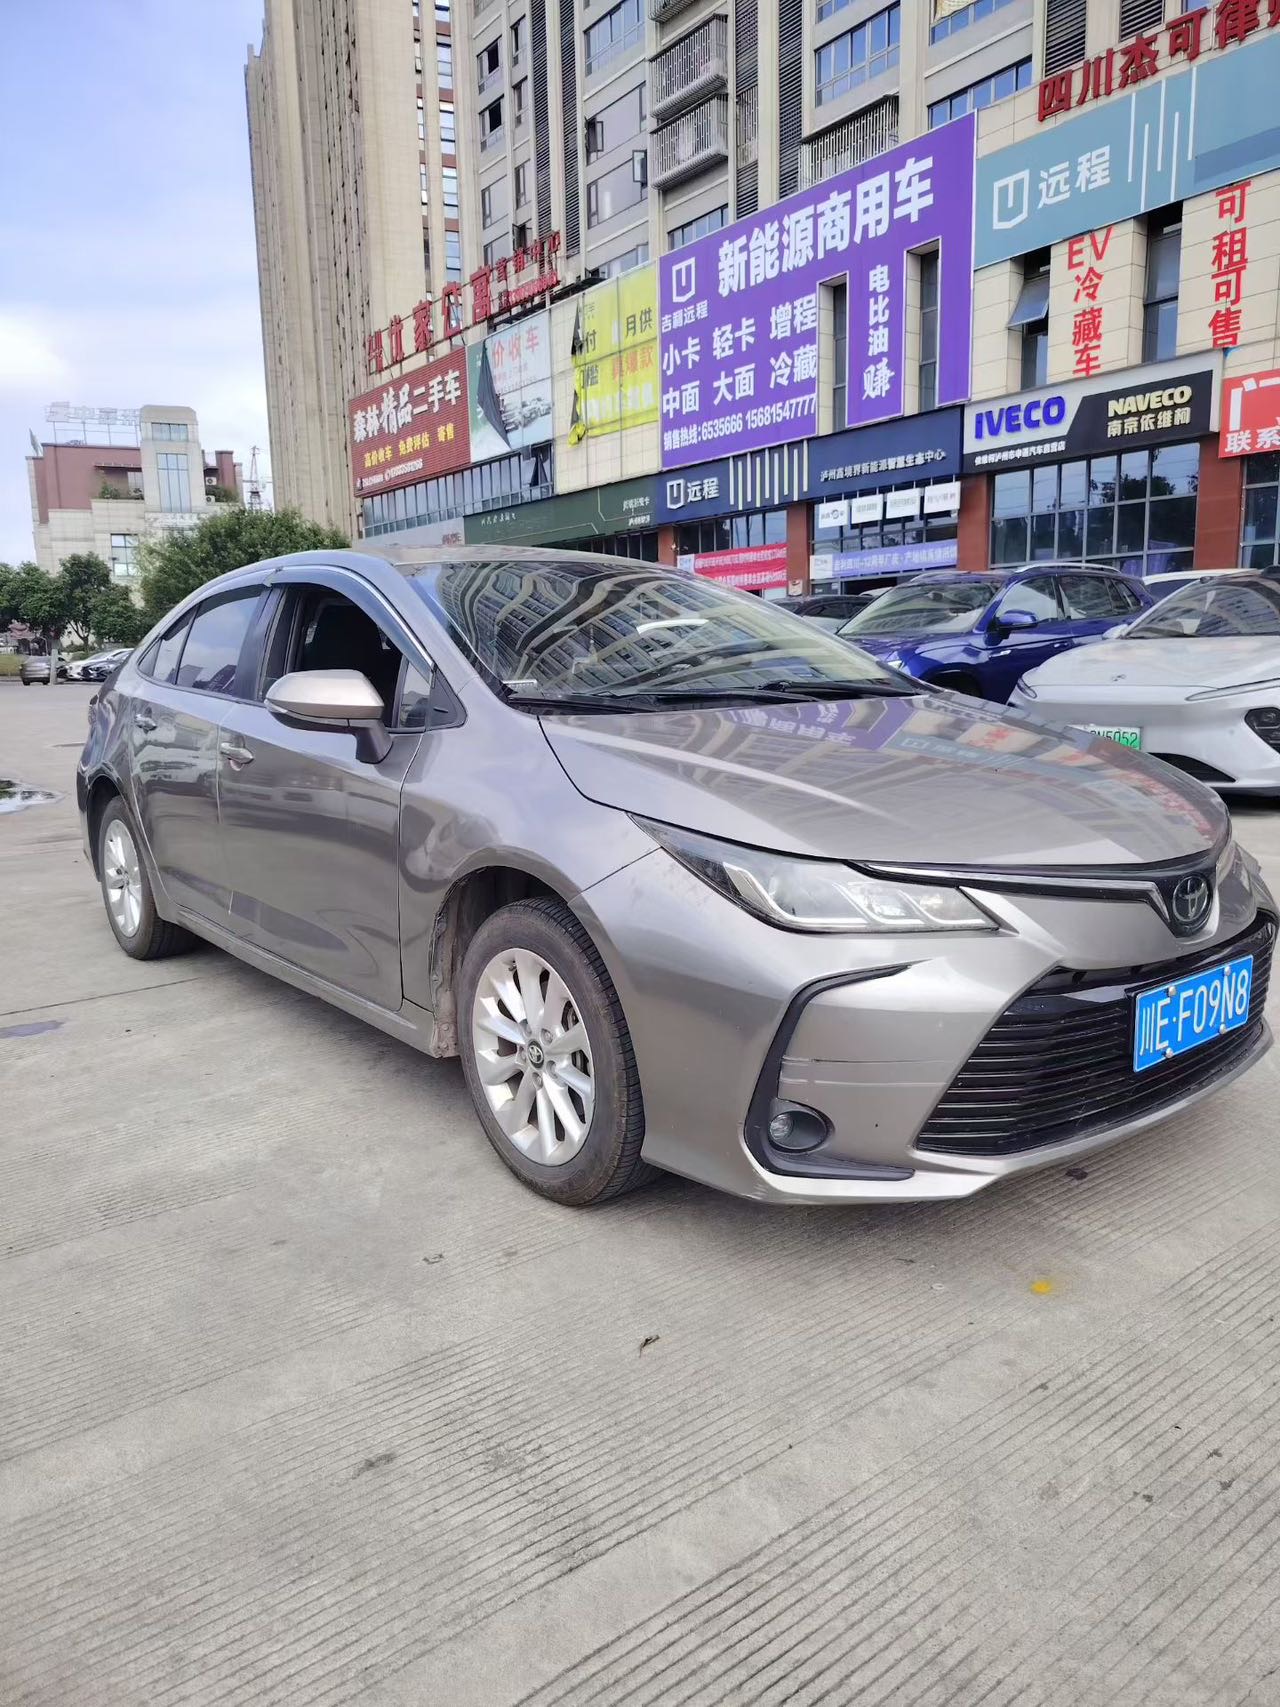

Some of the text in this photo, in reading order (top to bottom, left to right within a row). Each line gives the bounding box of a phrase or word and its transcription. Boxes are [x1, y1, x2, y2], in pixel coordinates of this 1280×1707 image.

[1038, 145, 1111, 209] 远程
[718, 156, 934, 298] 新能源商用车
[1067, 227, 1114, 271] EV
[1208, 181, 1252, 348] 可租可售
[626, 307, 653, 338] 月供
[662, 293, 817, 376] 小卡 轻卡 增程
[862, 263, 895, 400] 电比油赚
[1072, 266, 1104, 377] 冷藏车
[354, 369, 461, 442] 森林精品二手车
[662, 343, 817, 419] 中面 大面 冷藏
[746, 393, 817, 430] 15681547777
[1108, 385, 1192, 418] NAVECO
[975, 396, 1066, 440] IVECO
[1107, 407, 1191, 438] 南京依维柯
[687, 477, 720, 502] 远程
